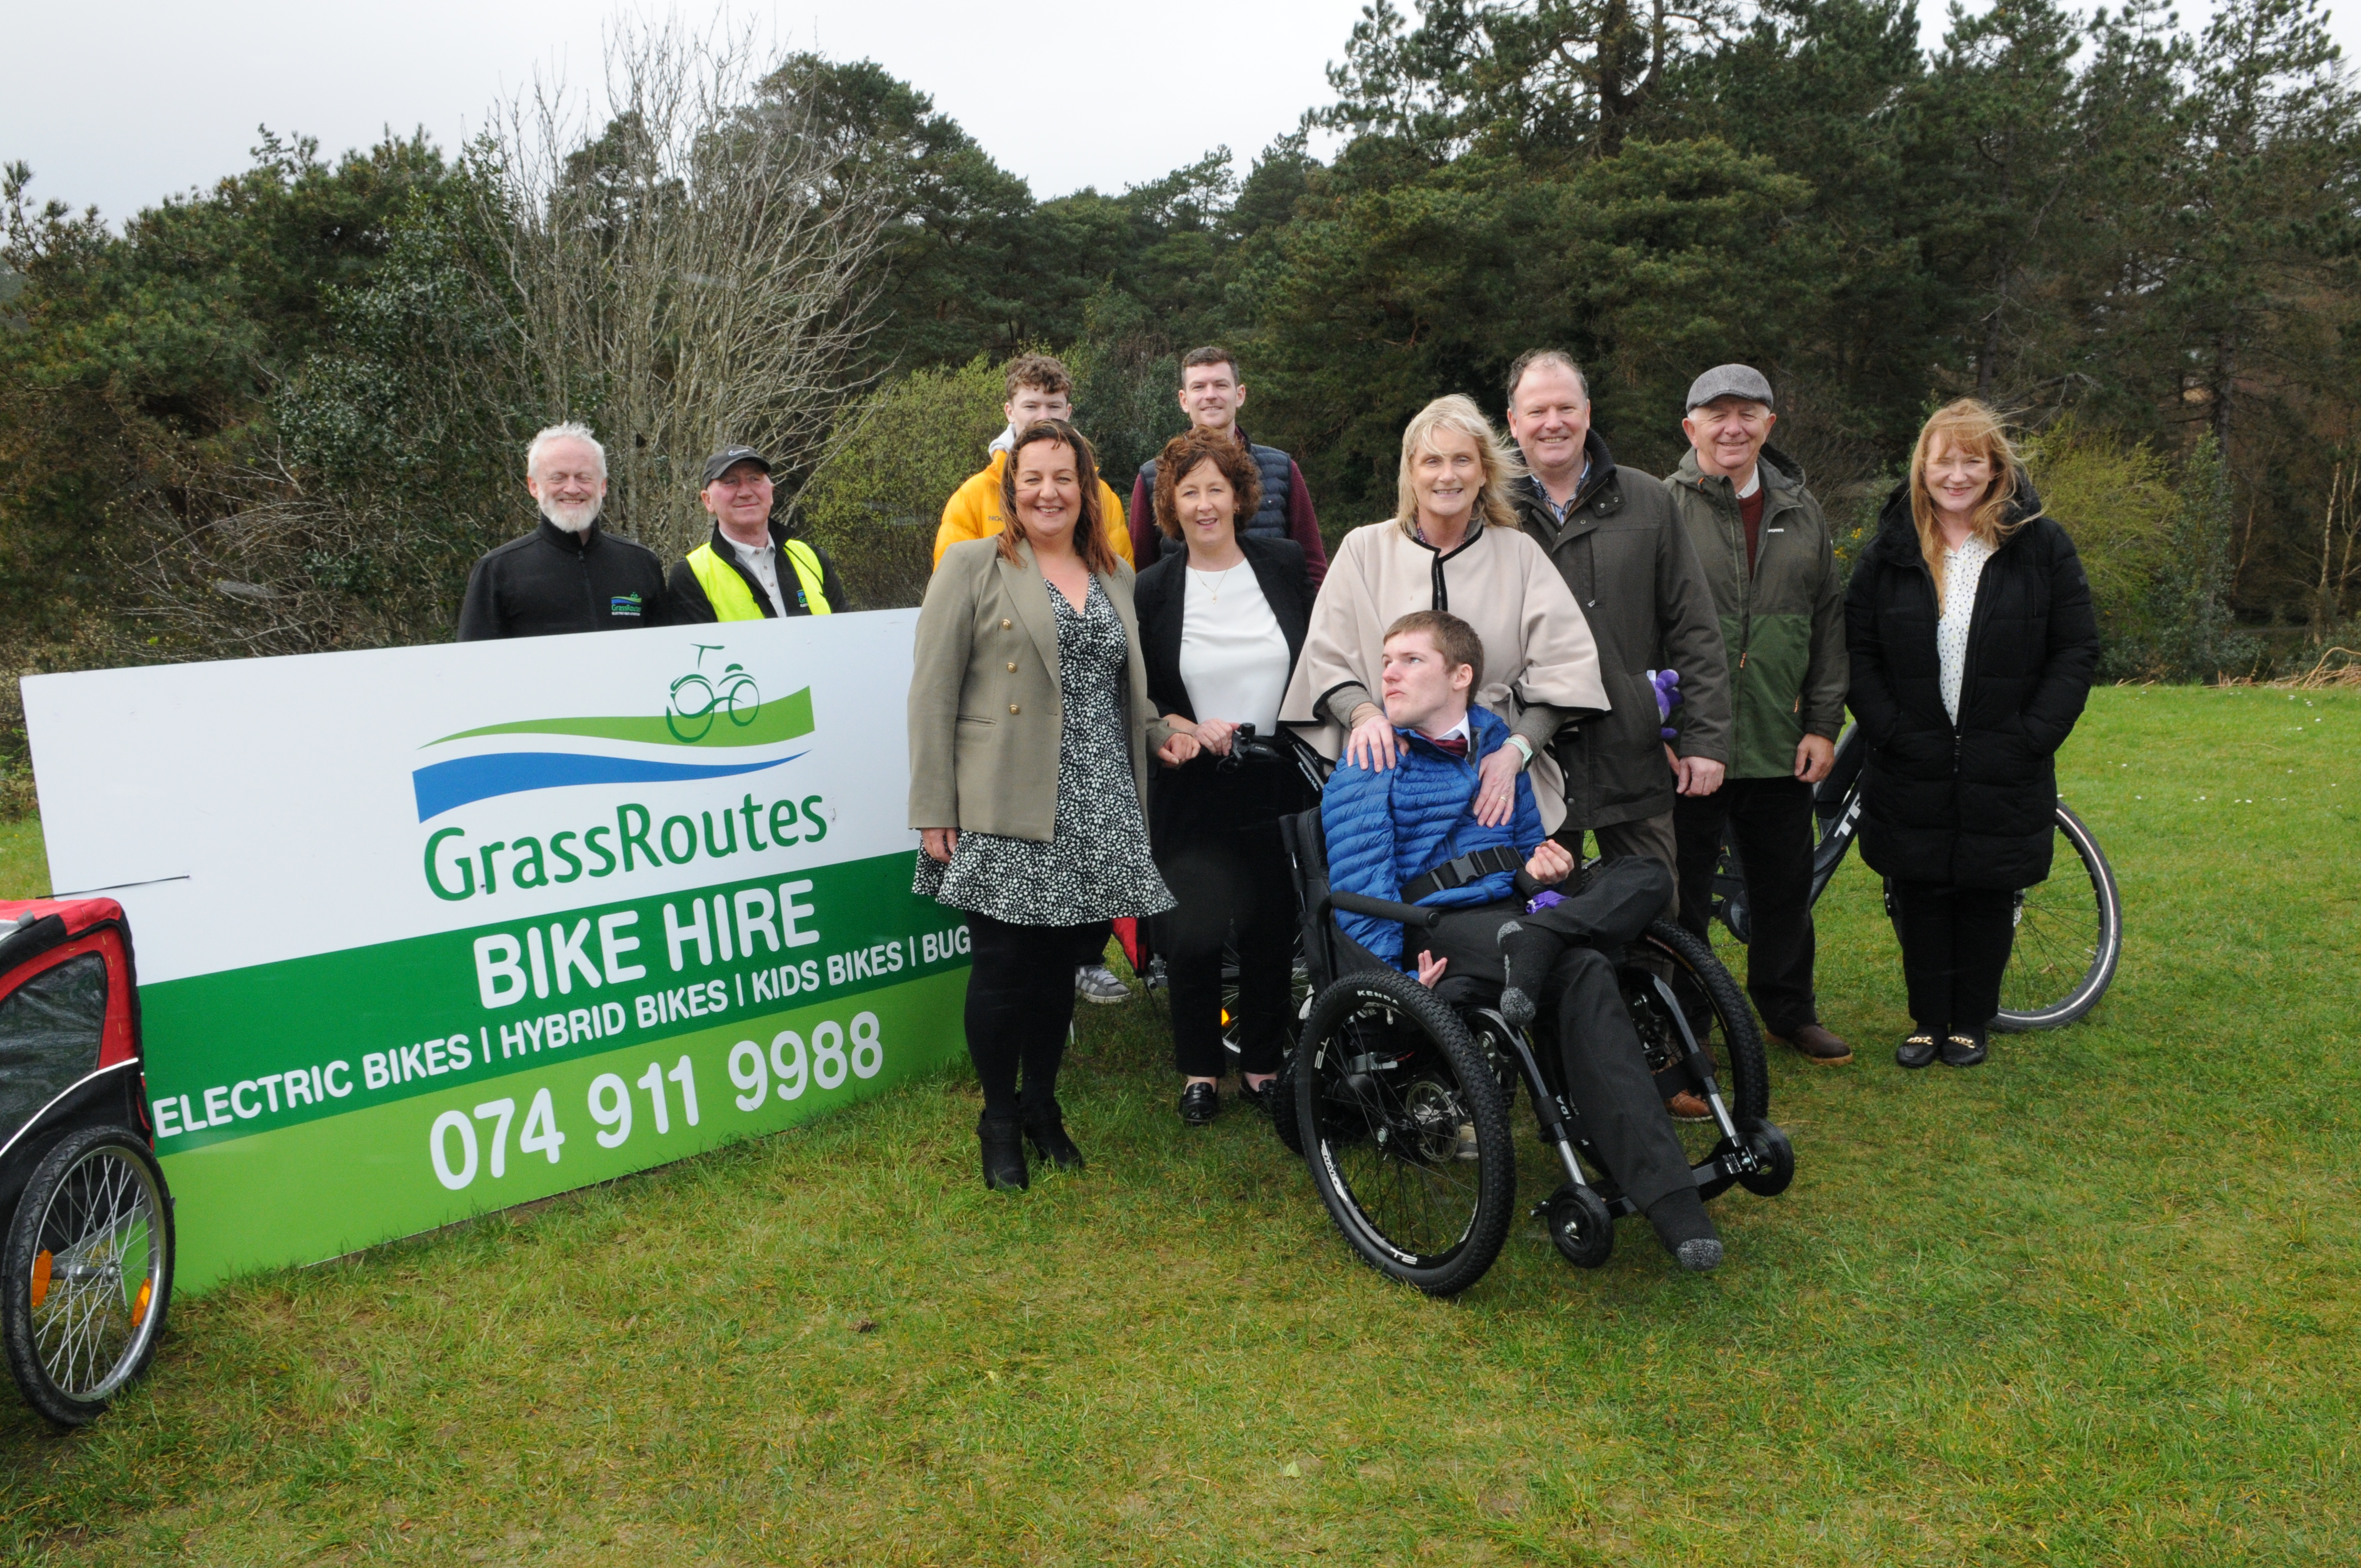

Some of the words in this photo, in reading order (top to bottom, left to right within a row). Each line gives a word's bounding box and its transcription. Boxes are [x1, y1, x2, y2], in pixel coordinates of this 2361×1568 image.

[424, 793, 828, 901] GrassRoutes
[474, 910, 646, 1009] BIKE
[663, 879, 819, 971] HIRE
[1357, 990, 1399, 1005] KENDA
[152, 1060, 352, 1137] ELECTRIC
[362, 1033, 472, 1090] BIKES
[501, 1001, 626, 1059] HYBRID
[635, 979, 728, 1028] BIKES
[752, 960, 820, 1003] KIDS
[826, 941, 904, 986] BIKES
[429, 1087, 565, 1191] 074
[587, 1054, 699, 1149] 911
[727, 1010, 884, 1112] 9988
